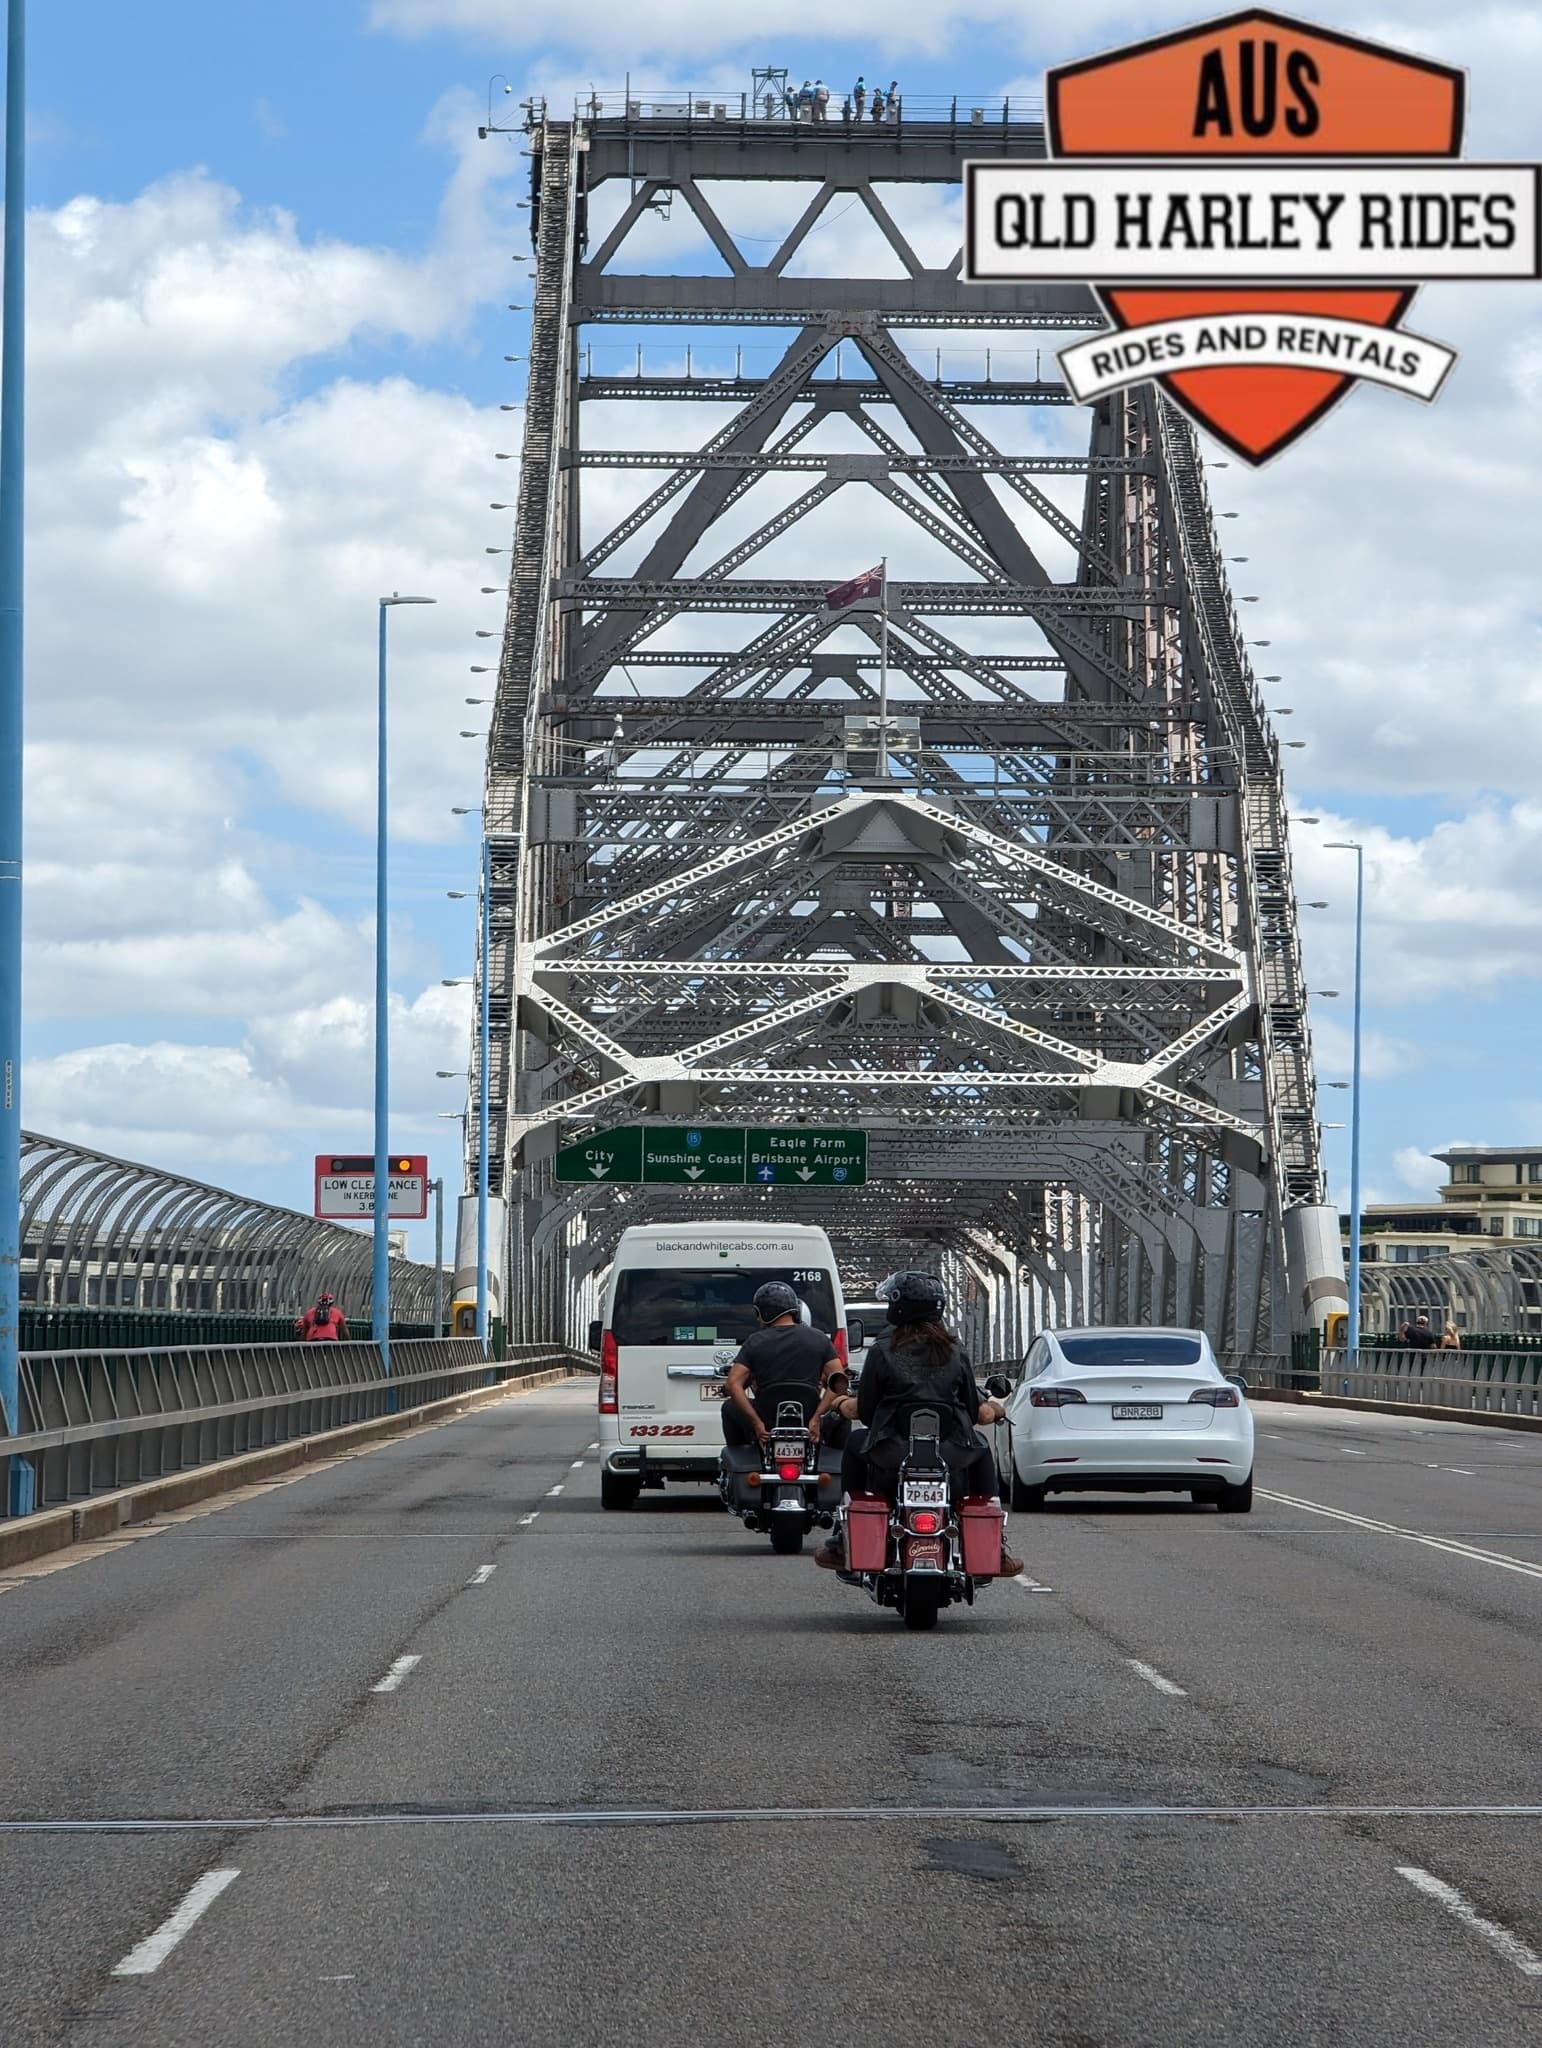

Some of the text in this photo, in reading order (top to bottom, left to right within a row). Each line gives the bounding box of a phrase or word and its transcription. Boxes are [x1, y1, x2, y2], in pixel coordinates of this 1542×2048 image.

[770, 1137, 846, 1149] Eagle Farm
[585, 1150, 614, 1163] City
[646, 1153, 743, 1164] Sunshine Coast
[751, 1153, 861, 1166] Brisbane Airport
[324, 1179, 418, 1190] LOW CLEANCE
[343, 1192, 352, 1200] IN
[656, 1241, 794, 1252] blackandwhitecabs.com.au
[793, 1271, 822, 1282] 2168
[629, 1425, 695, 1437] 133 222
